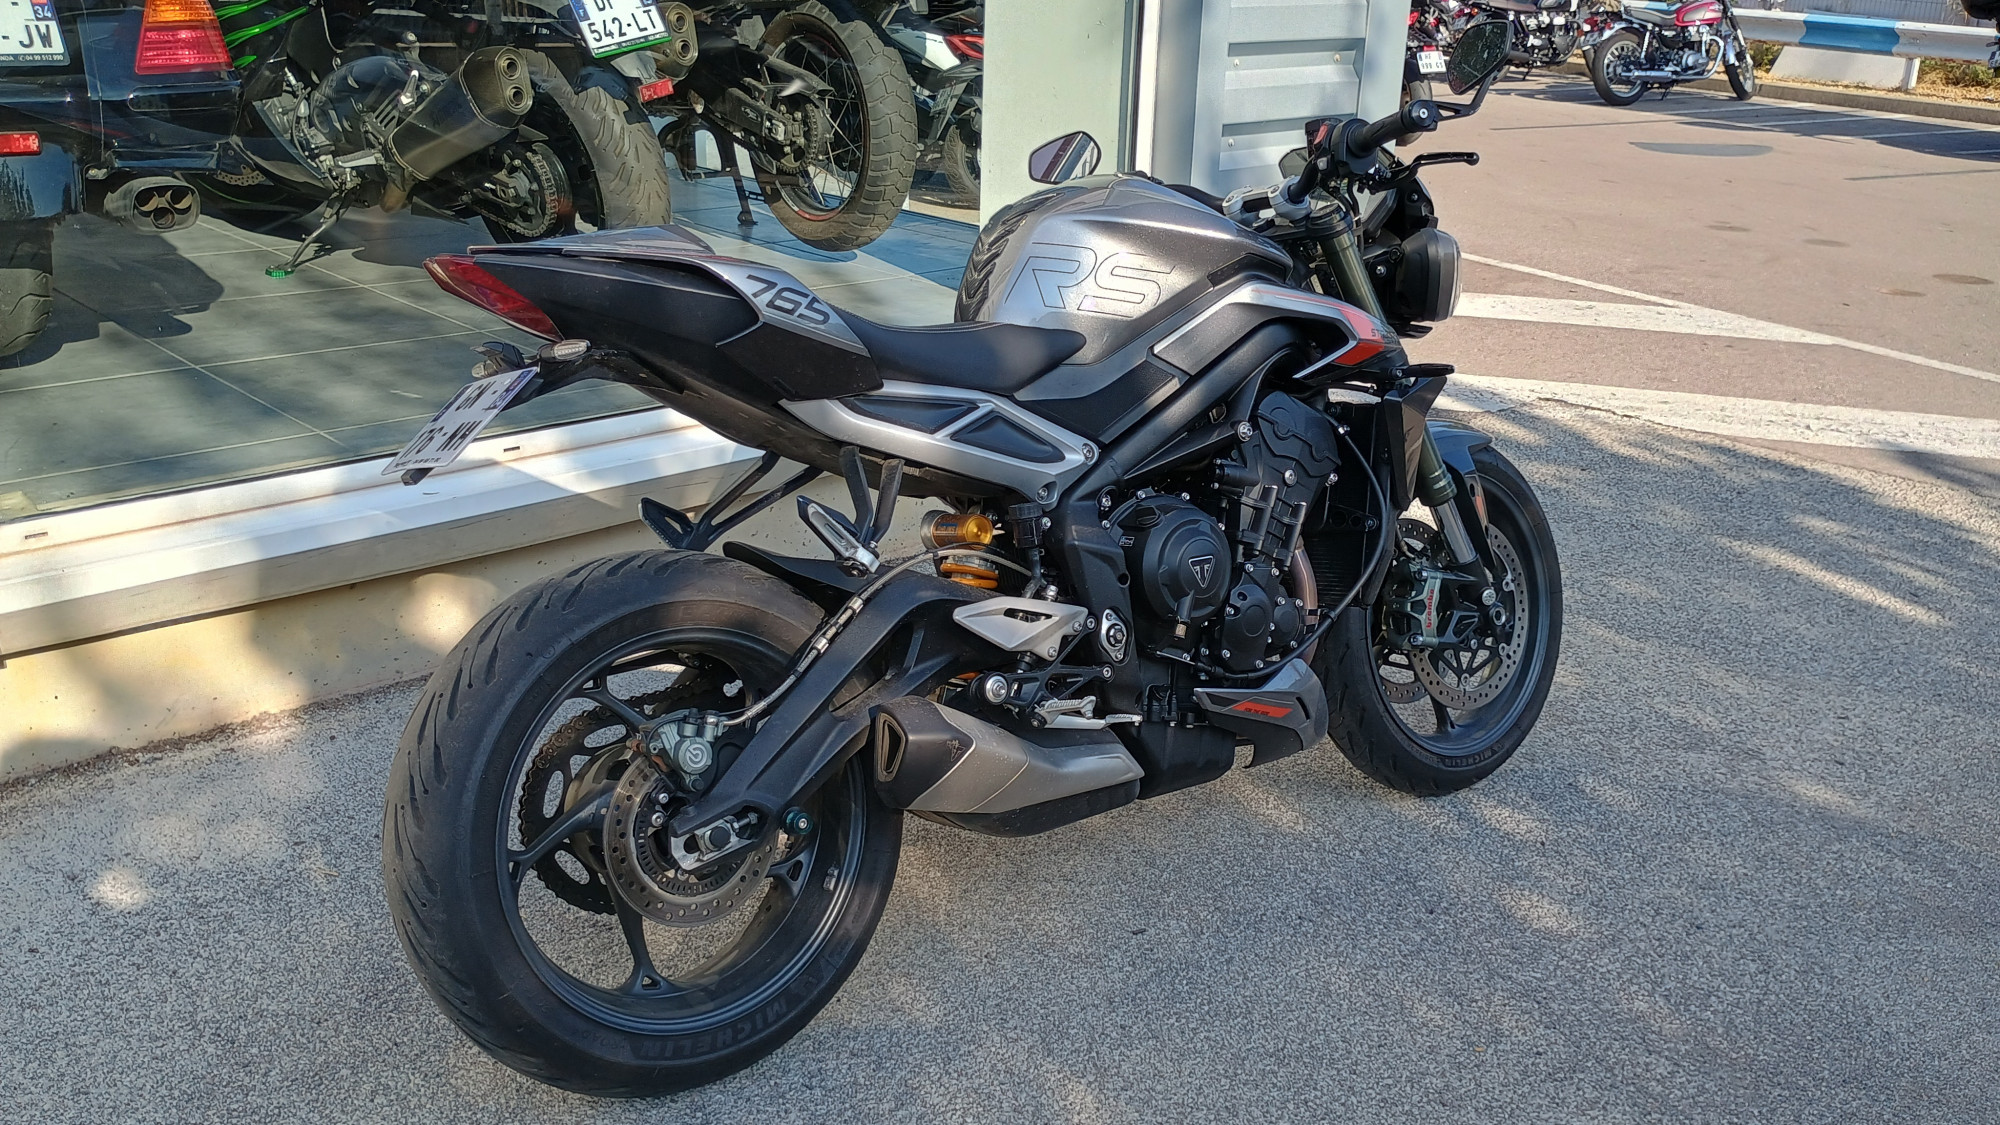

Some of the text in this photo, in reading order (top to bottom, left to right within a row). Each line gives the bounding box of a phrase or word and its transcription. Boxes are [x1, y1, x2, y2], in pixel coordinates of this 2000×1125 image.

[34, 6, 52, 18] 34
[587, 9, 656, 42] 542-LT
[746, 274, 830, 325] 765
[1004, 242, 1176, 318] RS
[400, 420, 483, 460] 176-NH
[1426, 589, 1434, 628] brembo
[1445, 749, 1492, 767] MICHELIN
[639, 998, 787, 1058] MICHELIN
